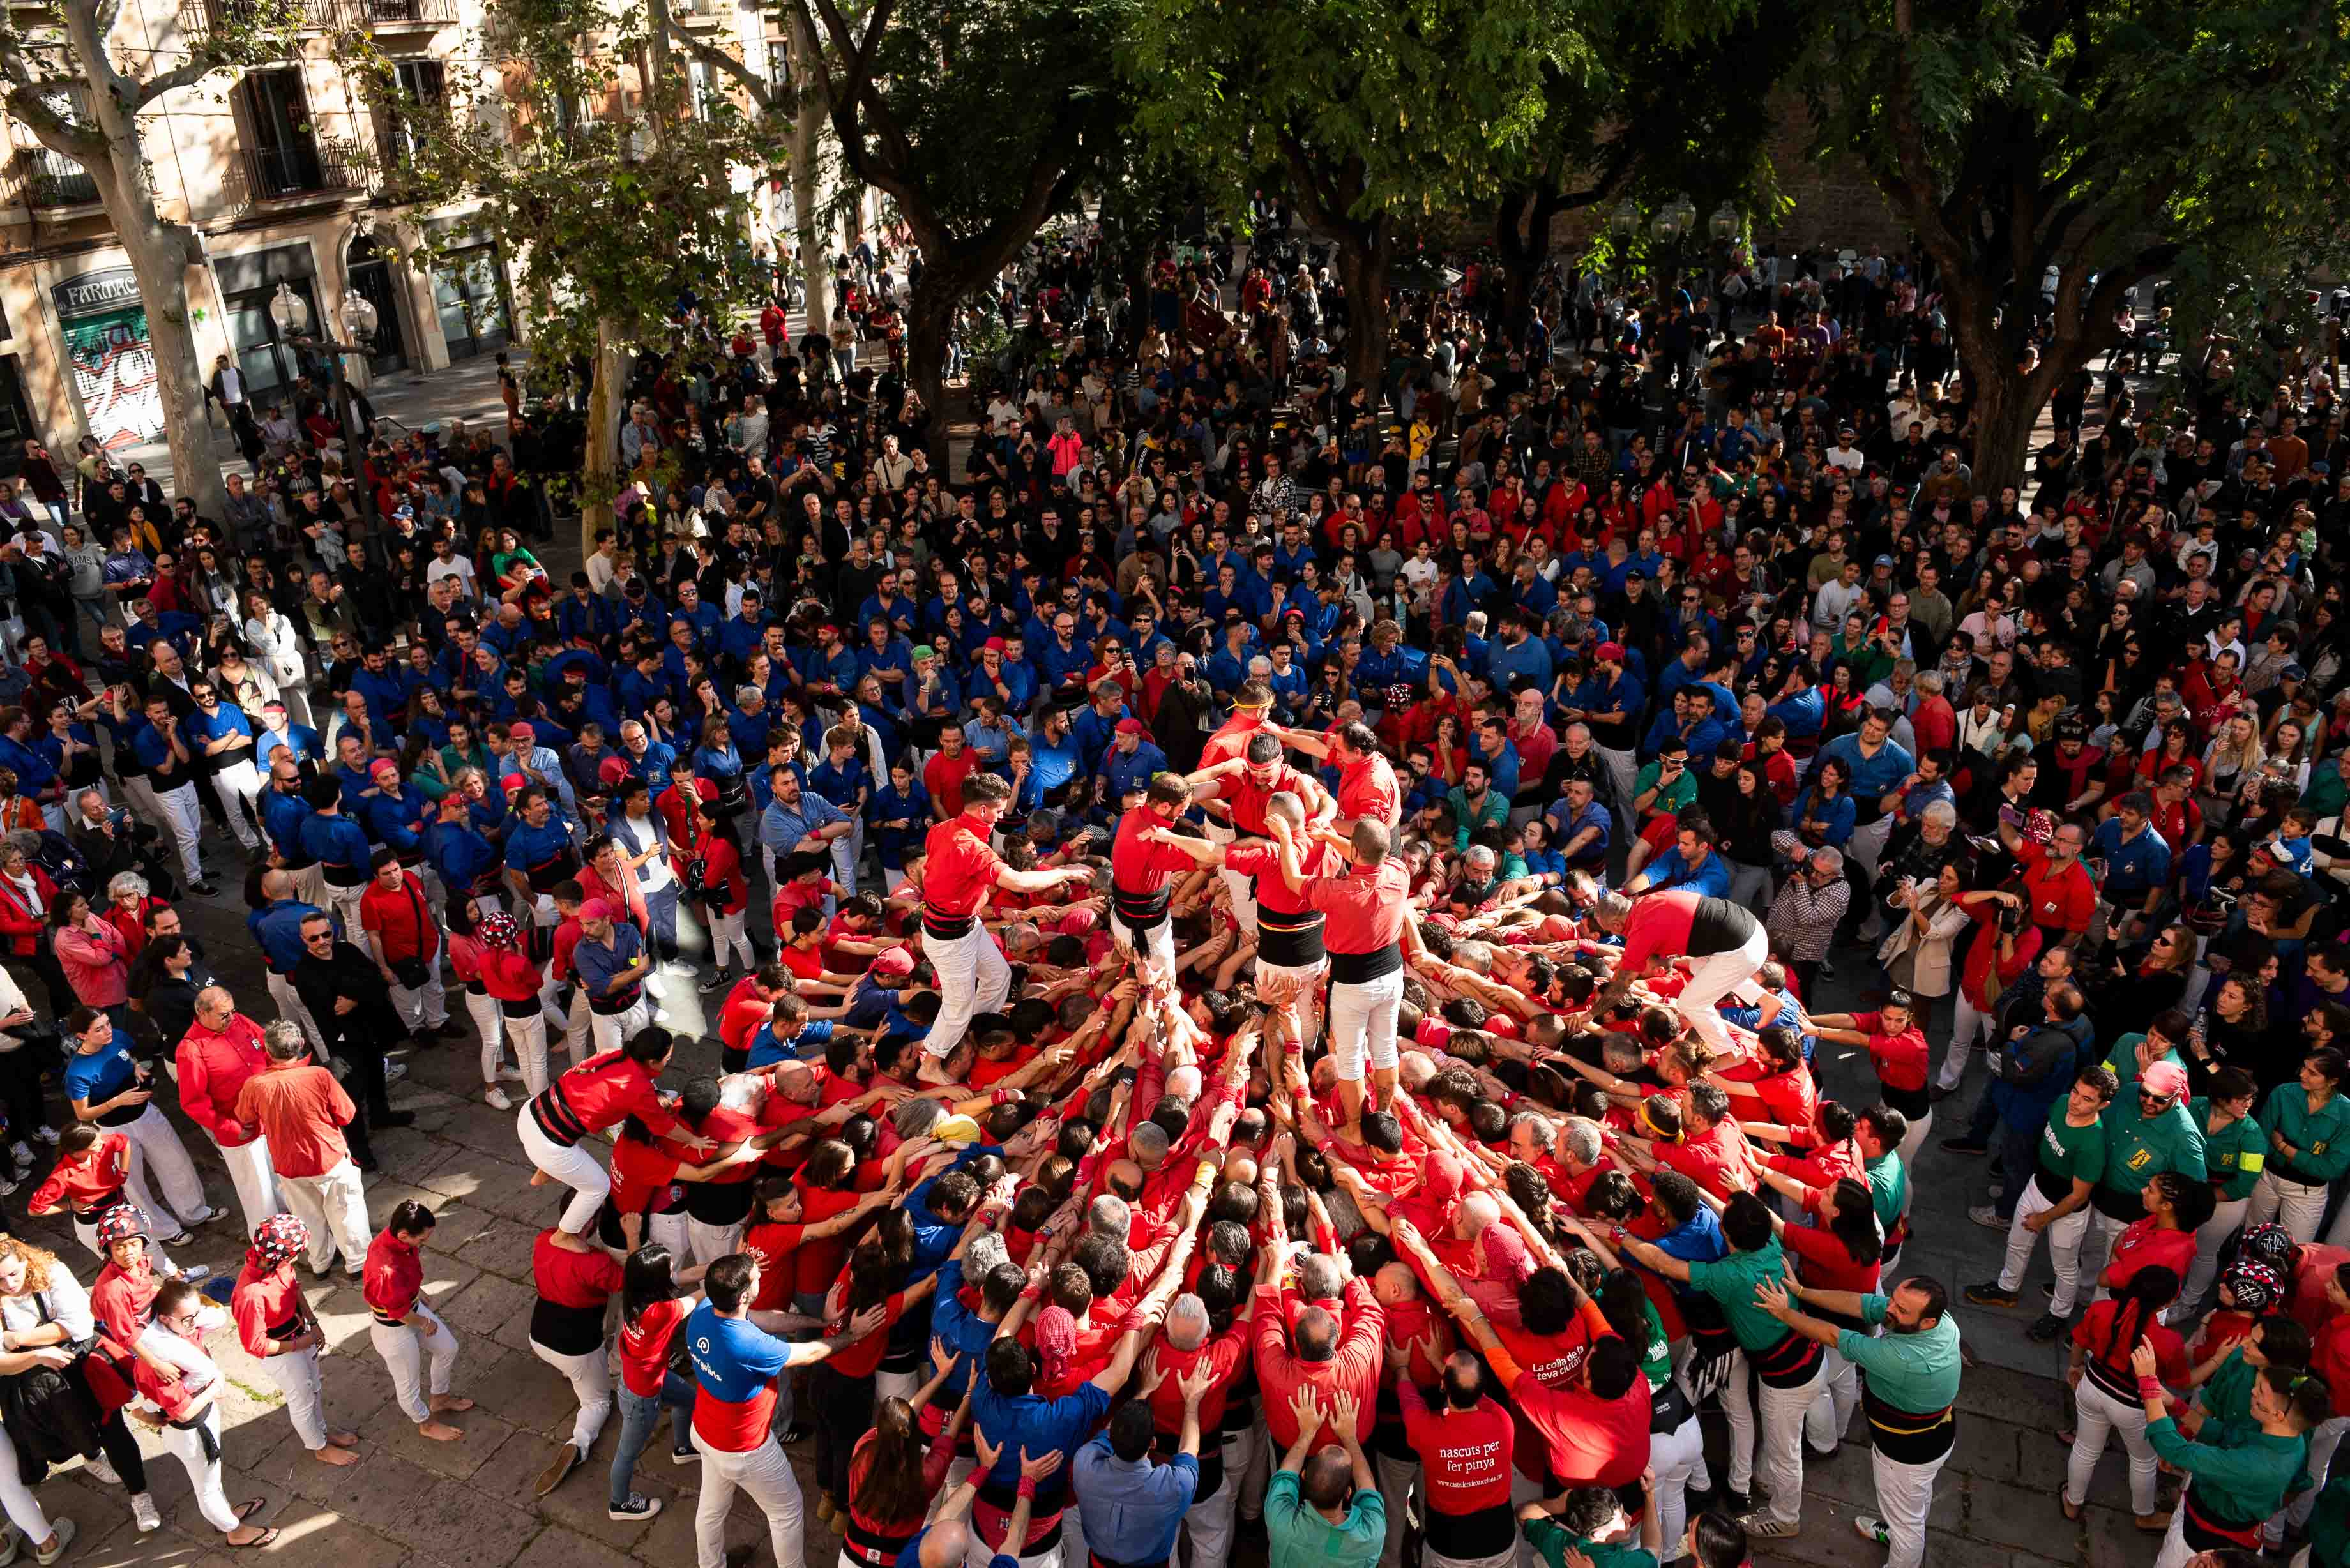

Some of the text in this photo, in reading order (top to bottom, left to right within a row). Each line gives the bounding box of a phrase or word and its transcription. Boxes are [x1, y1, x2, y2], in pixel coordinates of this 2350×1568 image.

[66, 276, 140, 305] FARMAC
[1533, 1345, 1584, 1372] La colla de la
[1537, 1370, 1558, 1380] teva
[1439, 1440, 1499, 1458] nascuts per
[1447, 1458, 1495, 1474] fer pinya
